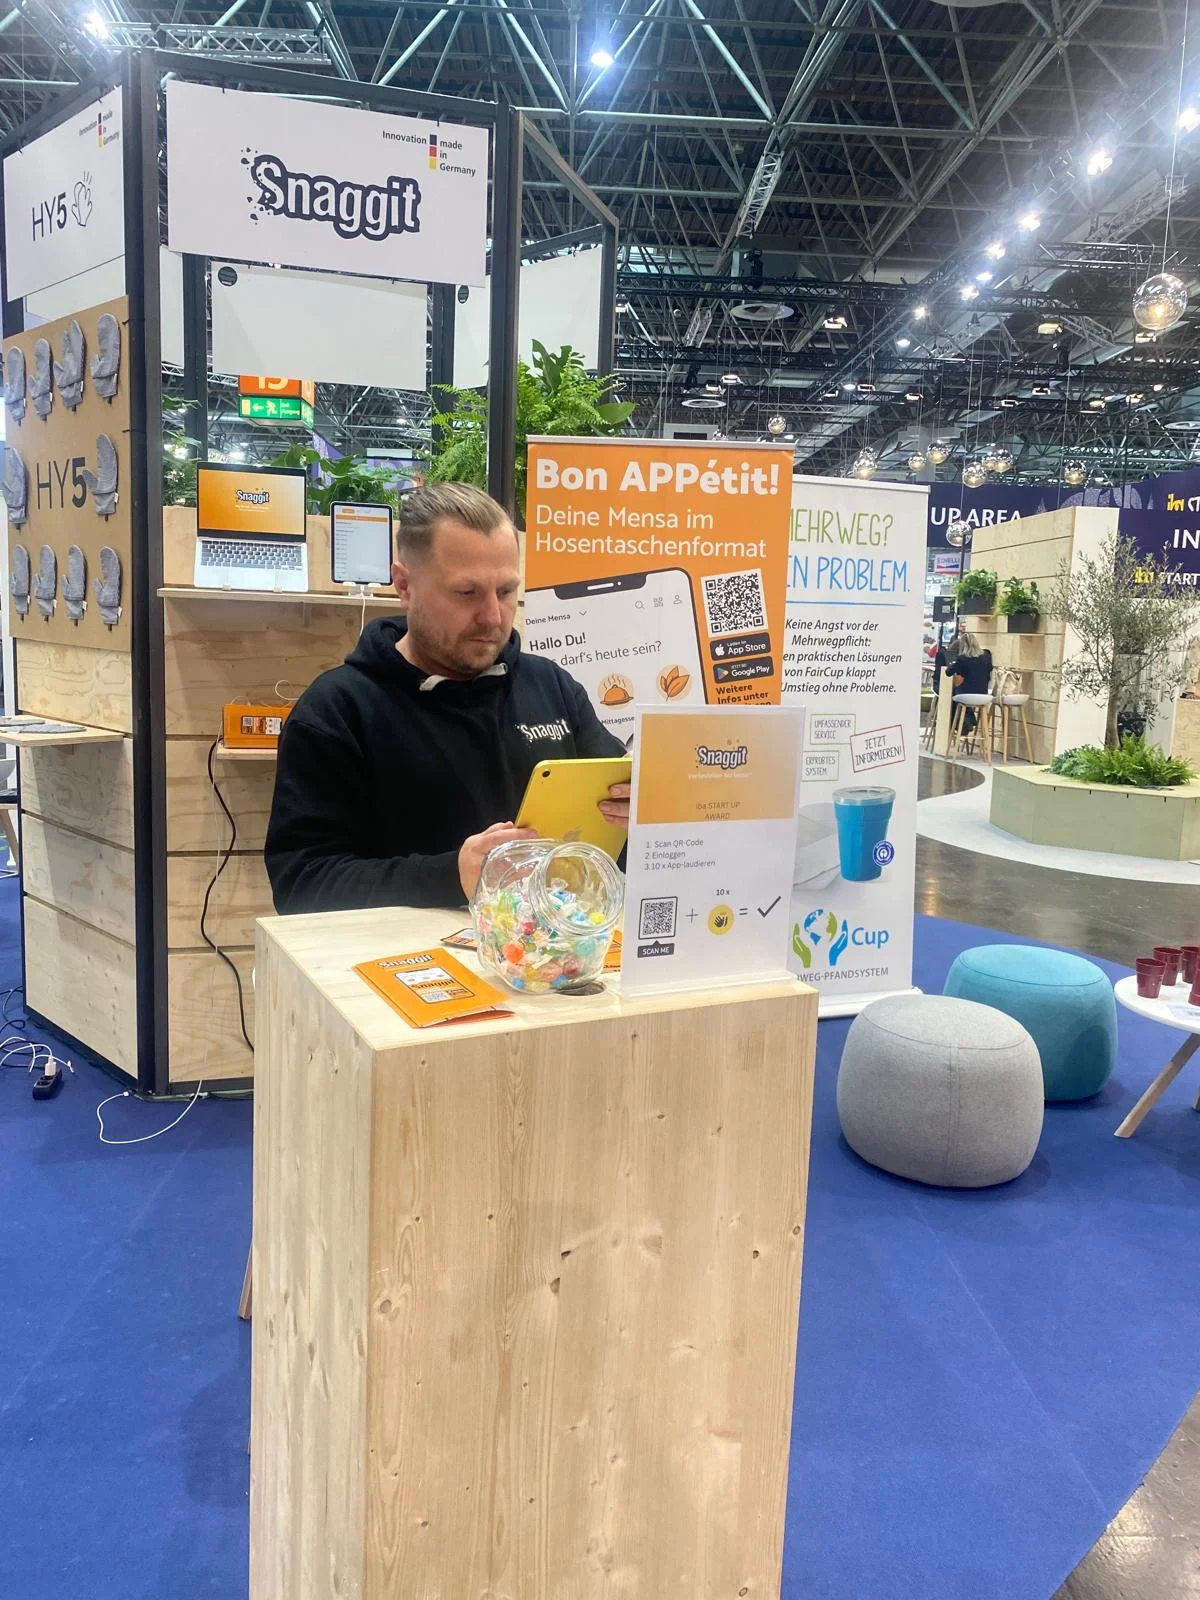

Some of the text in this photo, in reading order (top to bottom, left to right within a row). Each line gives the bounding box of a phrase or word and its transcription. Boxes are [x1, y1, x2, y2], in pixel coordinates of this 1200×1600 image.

[382, 130, 427, 145] Innovation
[439, 139, 463, 150] made
[439, 150, 448, 160] in
[439, 162, 476, 178] Germany
[250, 154, 422, 242] Snaggit
[32, 191, 67, 242] HY5
[36, 456, 88, 510] HY5
[536, 458, 779, 496] Bon APPétit!
[236, 489, 270, 505] Snaggit
[536, 504, 714, 529] Deine Mensa im
[930, 506, 962, 526] UP
[536, 532, 767, 558] Hosentaschenformat
[816, 555, 910, 593] PROBLEM.
[525, 613, 571, 626] Deine Mensa
[785, 618, 879, 634] Keine Angst vor der
[529, 632, 587, 651] Hallo Du!
[727, 643, 767, 655] App Store
[791, 634, 872, 649] Mehrwegpflicht:
[560, 640, 662, 667] darf's heute sein?
[796, 651, 856, 664] praktischen
[857, 652, 902, 664] Lösungen
[731, 665, 770, 677] Google Play
[784, 666, 876, 679] von FairCup klappt
[716, 684, 753, 695] Weitere
[781, 682, 897, 695] Umstieg ohne Probleme.
[717, 691, 769, 705] Infos unter
[520, 718, 571, 741] Snaggit
[864, 735, 886, 750] JETZT
[698, 745, 748, 770] Snaggit
[708, 801, 729, 809] START
[705, 812, 731, 820] AWARD
[654, 840, 671, 848] Scan
[652, 851, 686, 860] Einloggen
[716, 888, 725, 896] 10
[851, 927, 890, 949] Cup
[642, 946, 670, 956] SCAN ME
